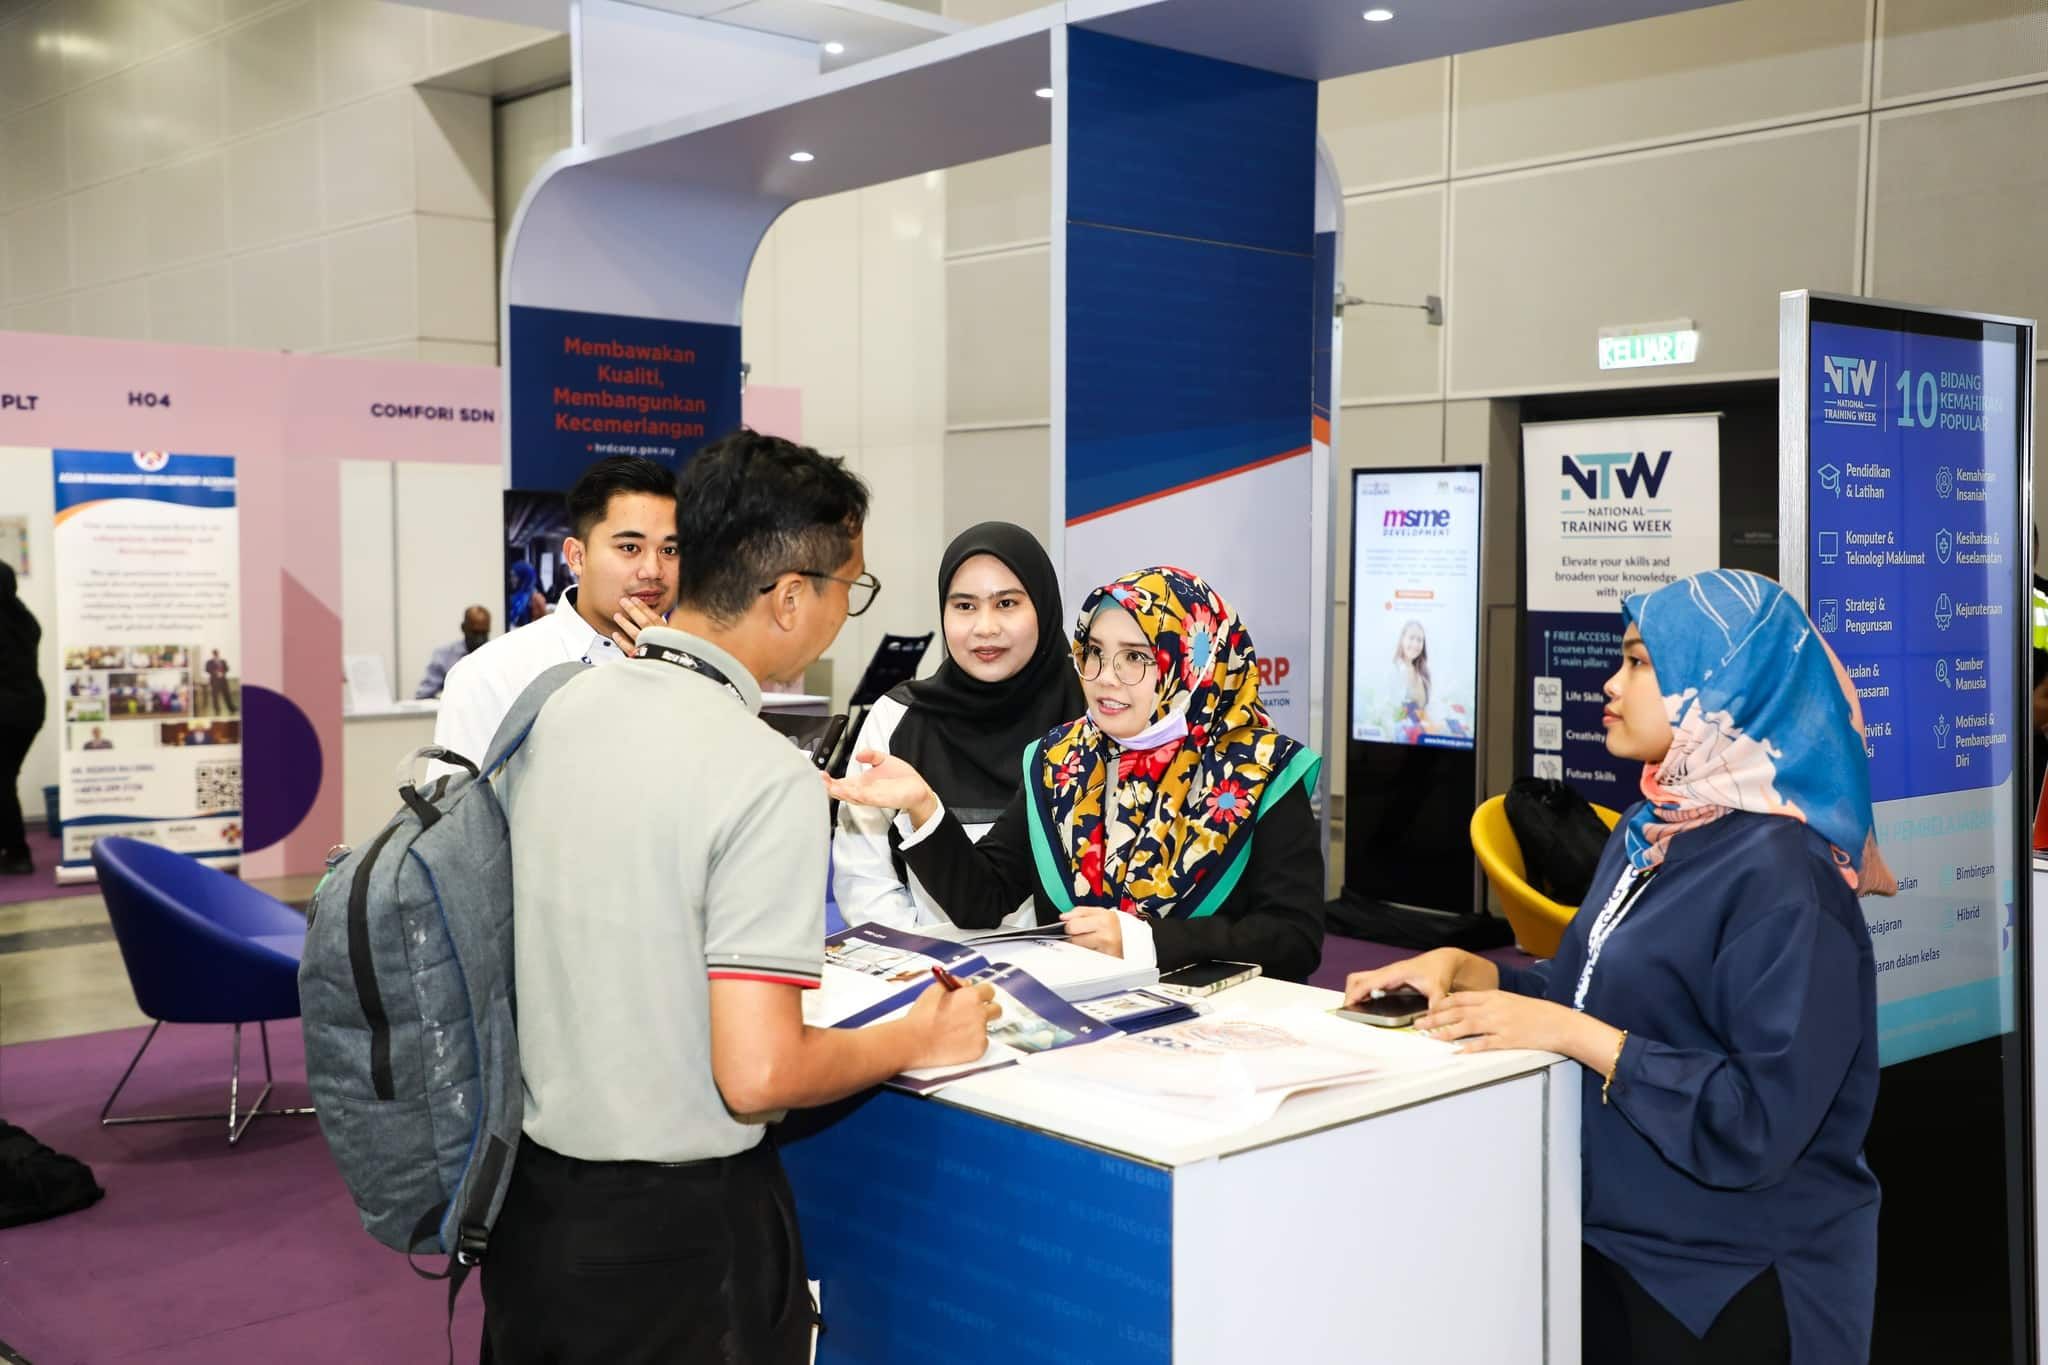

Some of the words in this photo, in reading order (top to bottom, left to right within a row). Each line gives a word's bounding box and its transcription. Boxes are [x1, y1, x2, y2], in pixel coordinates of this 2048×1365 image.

[564, 336, 696, 363] Membawakan
[597, 364, 664, 389] Kualiti,
[1824, 355, 1877, 396] NTW
[1941, 371, 1982, 390] BIDANG
[553, 387, 706, 413] Membangunkan
[1837, 399, 1864, 409] NATIONAL
[1896, 369, 1938, 428] 10
[371, 403, 454, 421] COMFORI
[460, 408, 495, 423] SDN
[1824, 408, 1856, 421] TRAINING
[1858, 410, 1877, 422] WEEK
[555, 412, 704, 439] Kecemerlangan
[1940, 412, 1989, 432] POPULAR
[1561, 450, 1672, 501] NTW
[1846, 463, 1891, 479] Pendidikan
[1846, 485, 1854, 498] &
[1855, 484, 1884, 499] Latihan
[1956, 488, 1987, 502] Insaniah
[1383, 509, 1451, 527] msme
[1588, 506, 1646, 517] NATIONAL
[1561, 520, 1628, 533] TRAINING
[1633, 519, 1672, 532] WEEK
[1846, 531, 1886, 547] Komputer
[1887, 532, 1894, 544] &
[1956, 531, 1991, 545] Kesihatan
[1562, 556, 1597, 568] Elevate
[1600, 558, 1621, 570] your
[1625, 555, 1650, 567] skills
[1652, 556, 1670, 567] and
[1846, 552, 1884, 567] Teknologi
[1886, 551, 1925, 566] Maklumat
[1956, 551, 2002, 565] Keselamatan
[1555, 571, 1595, 582] broaden
[1597, 574, 1622, 585] your
[1622, 571, 1677, 584] knowledge
[1596, 586, 1618, 597] with
[1846, 598, 1876, 613] Strategi
[1878, 599, 1885, 611] &
[1955, 603, 2002, 618] Kejuruteraan
[1846, 619, 1892, 634] Pengurusan
[1553, 631, 1575, 642] FREE
[1577, 631, 1611, 643] ACCESS
[1553, 645, 1586, 655] courses
[1587, 645, 1604, 656] that
[1561, 658, 1582, 667] main
[1872, 663, 1880, 677] &
[1955, 658, 1984, 672] Sumber
[1256, 657, 1290, 687] RP
[1955, 676, 1986, 690] Manusia
[1566, 692, 1582, 701] Life
[1583, 692, 1604, 703] Skills
[1856, 686, 1889, 698] masaran
[1955, 713, 1988, 728] Motivasi
[1566, 730, 1606, 744] Creativity
[1864, 722, 1884, 737] tiviti
[1885, 722, 1893, 736] &
[1955, 733, 2007, 748] Pembangunan
[1955, 754, 1970, 768] Diri
[1566, 768, 1592, 780] Future
[1594, 770, 1616, 782] Skills
[1956, 863, 1995, 881] Bimbingan
[1957, 906, 1980, 922] Hibrid
[1866, 919, 1903, 936] belajaran
[1896, 952, 1920, 969] dalam
[1921, 947, 1940, 963] kelas
